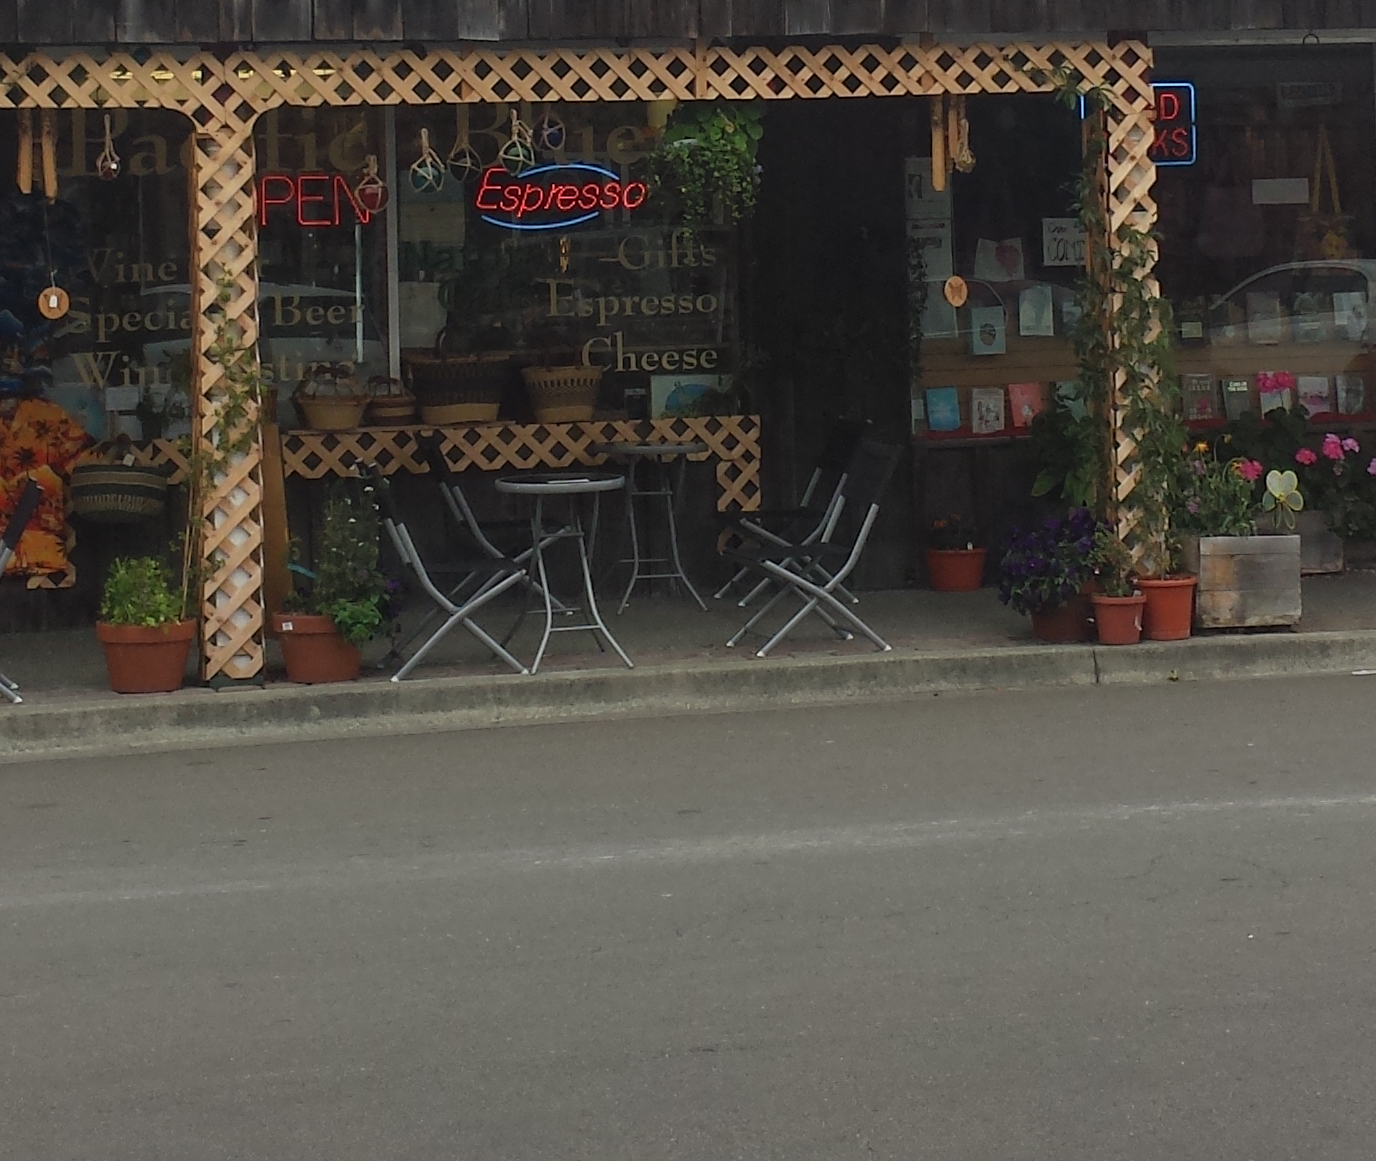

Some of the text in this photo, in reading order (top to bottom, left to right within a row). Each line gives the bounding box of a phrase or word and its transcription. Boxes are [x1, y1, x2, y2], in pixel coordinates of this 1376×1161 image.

[258, 174, 372, 227] PEN
[475, 165, 648, 218] Espresso
[617, 233, 718, 270] Gifts
[272, 293, 366, 326] Beer
[543, 278, 718, 326] Espresso
[69, 350, 172, 390] Win
[581, 332, 718, 372] Cheese
